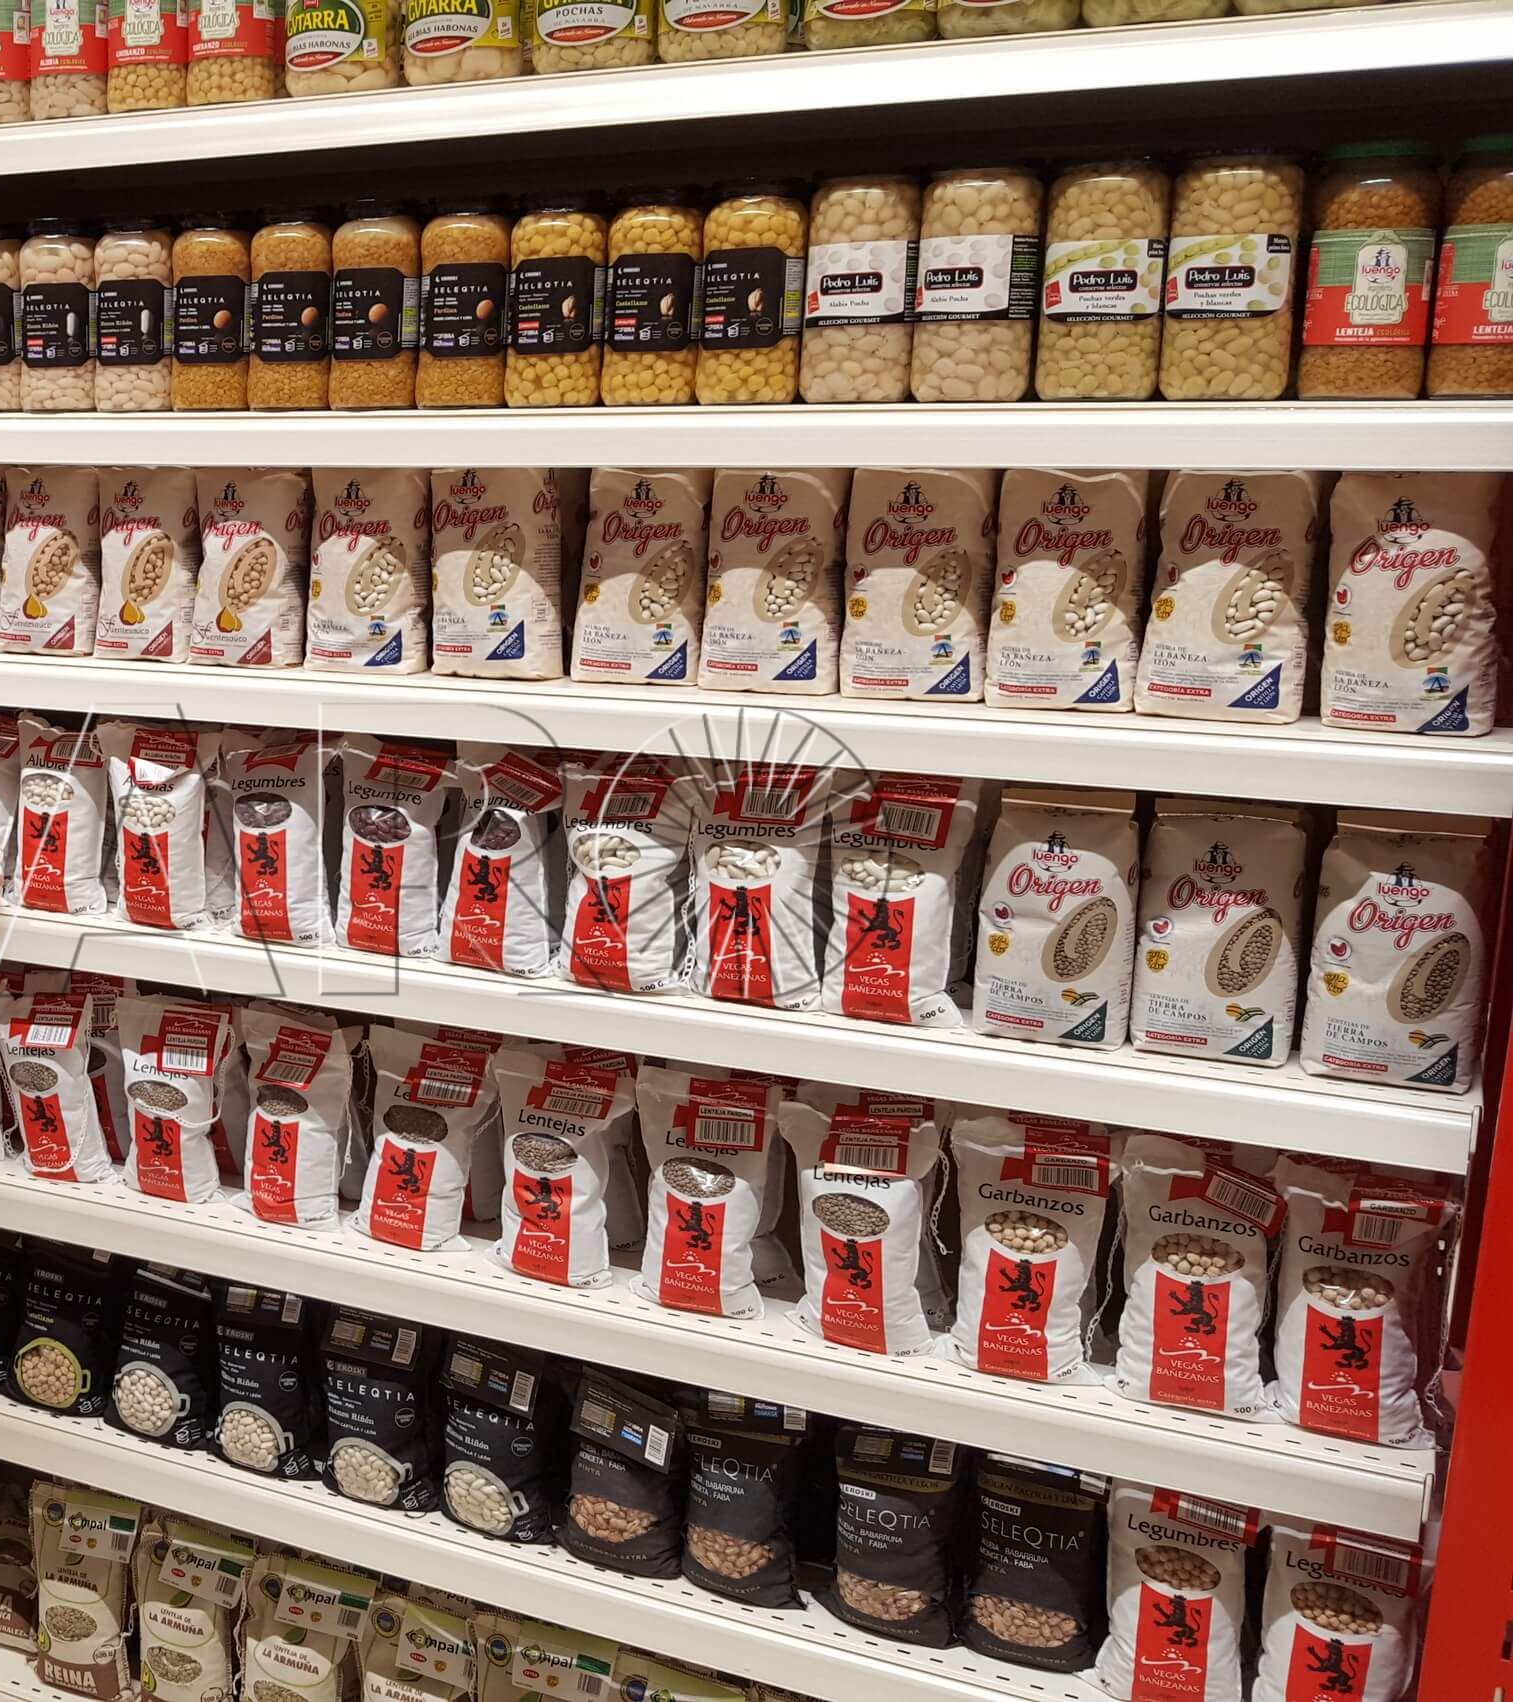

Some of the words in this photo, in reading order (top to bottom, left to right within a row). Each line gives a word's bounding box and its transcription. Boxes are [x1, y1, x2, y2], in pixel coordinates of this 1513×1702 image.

[555, 6, 603, 18] POCHAS
[434, 24, 478, 33] HABONAS
[308, 40, 351, 49] HABONAS
[955, 270, 979, 282] Luis
[1110, 273, 1133, 284] Luis
[1225, 268, 1250, 280] Luis
[1361, 263, 1401, 279] luengo
[855, 276, 879, 287] Luis
[1336, 328, 1374, 336] LENTEJA
[8, 509, 66, 541] Origen
[101, 512, 161, 544] Origen
[433, 501, 507, 539] Origen
[203, 516, 262, 550] Origen
[319, 511, 390, 552] Origen
[602, 511, 681, 556] Origen
[720, 506, 810, 553] Origen
[864, 518, 957, 566] Origen
[1015, 519, 1113, 568] Origen
[1179, 515, 1283, 566] Origen
[1351, 536, 1461, 590] Origen
[232, 776, 306, 791] Legumbres
[698, 821, 795, 838] Legumbres
[1033, 849, 1079, 867] luengo
[1193, 860, 1242, 877] luengo
[1007, 862, 1102, 912] Origen
[1377, 882, 1430, 899] luengo
[1167, 875, 1268, 924] Origen
[1347, 897, 1457, 950] Origen
[584, 947, 609, 958] VEGAS
[859, 976, 888, 986] VEGAS
[991, 982, 1022, 994] TIERRA
[848, 984, 903, 998] BAÑEZANAS
[1002, 992, 1044, 1005] CAMPOS
[1149, 998, 1181, 1013] TIERRA
[1162, 1009, 1207, 1022] CAMPOS
[1327, 1023, 1363, 1037] TIERRA
[1340, 1034, 1388, 1047] CAMPOS
[519, 1110, 585, 1137] Lentejas
[978, 1181, 1086, 1216] Garbanzos
[385, 1209, 409, 1221] VEGAS
[1369, 1203, 1417, 1216] GARBANZO
[1148, 1204, 1259, 1238] Garbanzos
[528, 1240, 553, 1252] VEGAS
[1298, 1235, 1411, 1268] Garbanzos
[675, 1271, 702, 1282] VEGAS
[836, 1308, 864, 1321] VEGAS
[995, 1334, 1030, 1346] VEGAS
[983, 1341, 1042, 1357] BAÑEZANAS
[1170, 1358, 1205, 1372] VEGAS
[1156, 1367, 1220, 1384] BAÑEZANAS
[1320, 1393, 1357, 1407] VEGAS
[1306, 1400, 1373, 1417] BAÑEZANAS
[843, 1487, 875, 1499] EROSKI
[840, 1499, 932, 1529] SELEQTIA
[989, 1501, 1020, 1515] EROSKI
[981, 1511, 1079, 1551] SELEQTIA
[1128, 1514, 1240, 1553] Legumbres
[868, 1540, 888, 1550] FABA
[1014, 1559, 1034, 1570] FABA
[278, 1657, 320, 1676] ARMUÑA
[44, 1663, 95, 1689] REINA
[1153, 1668, 1186, 1682] VEGAS
[1139, 1674, 1200, 1693] BAÑEZANAS
